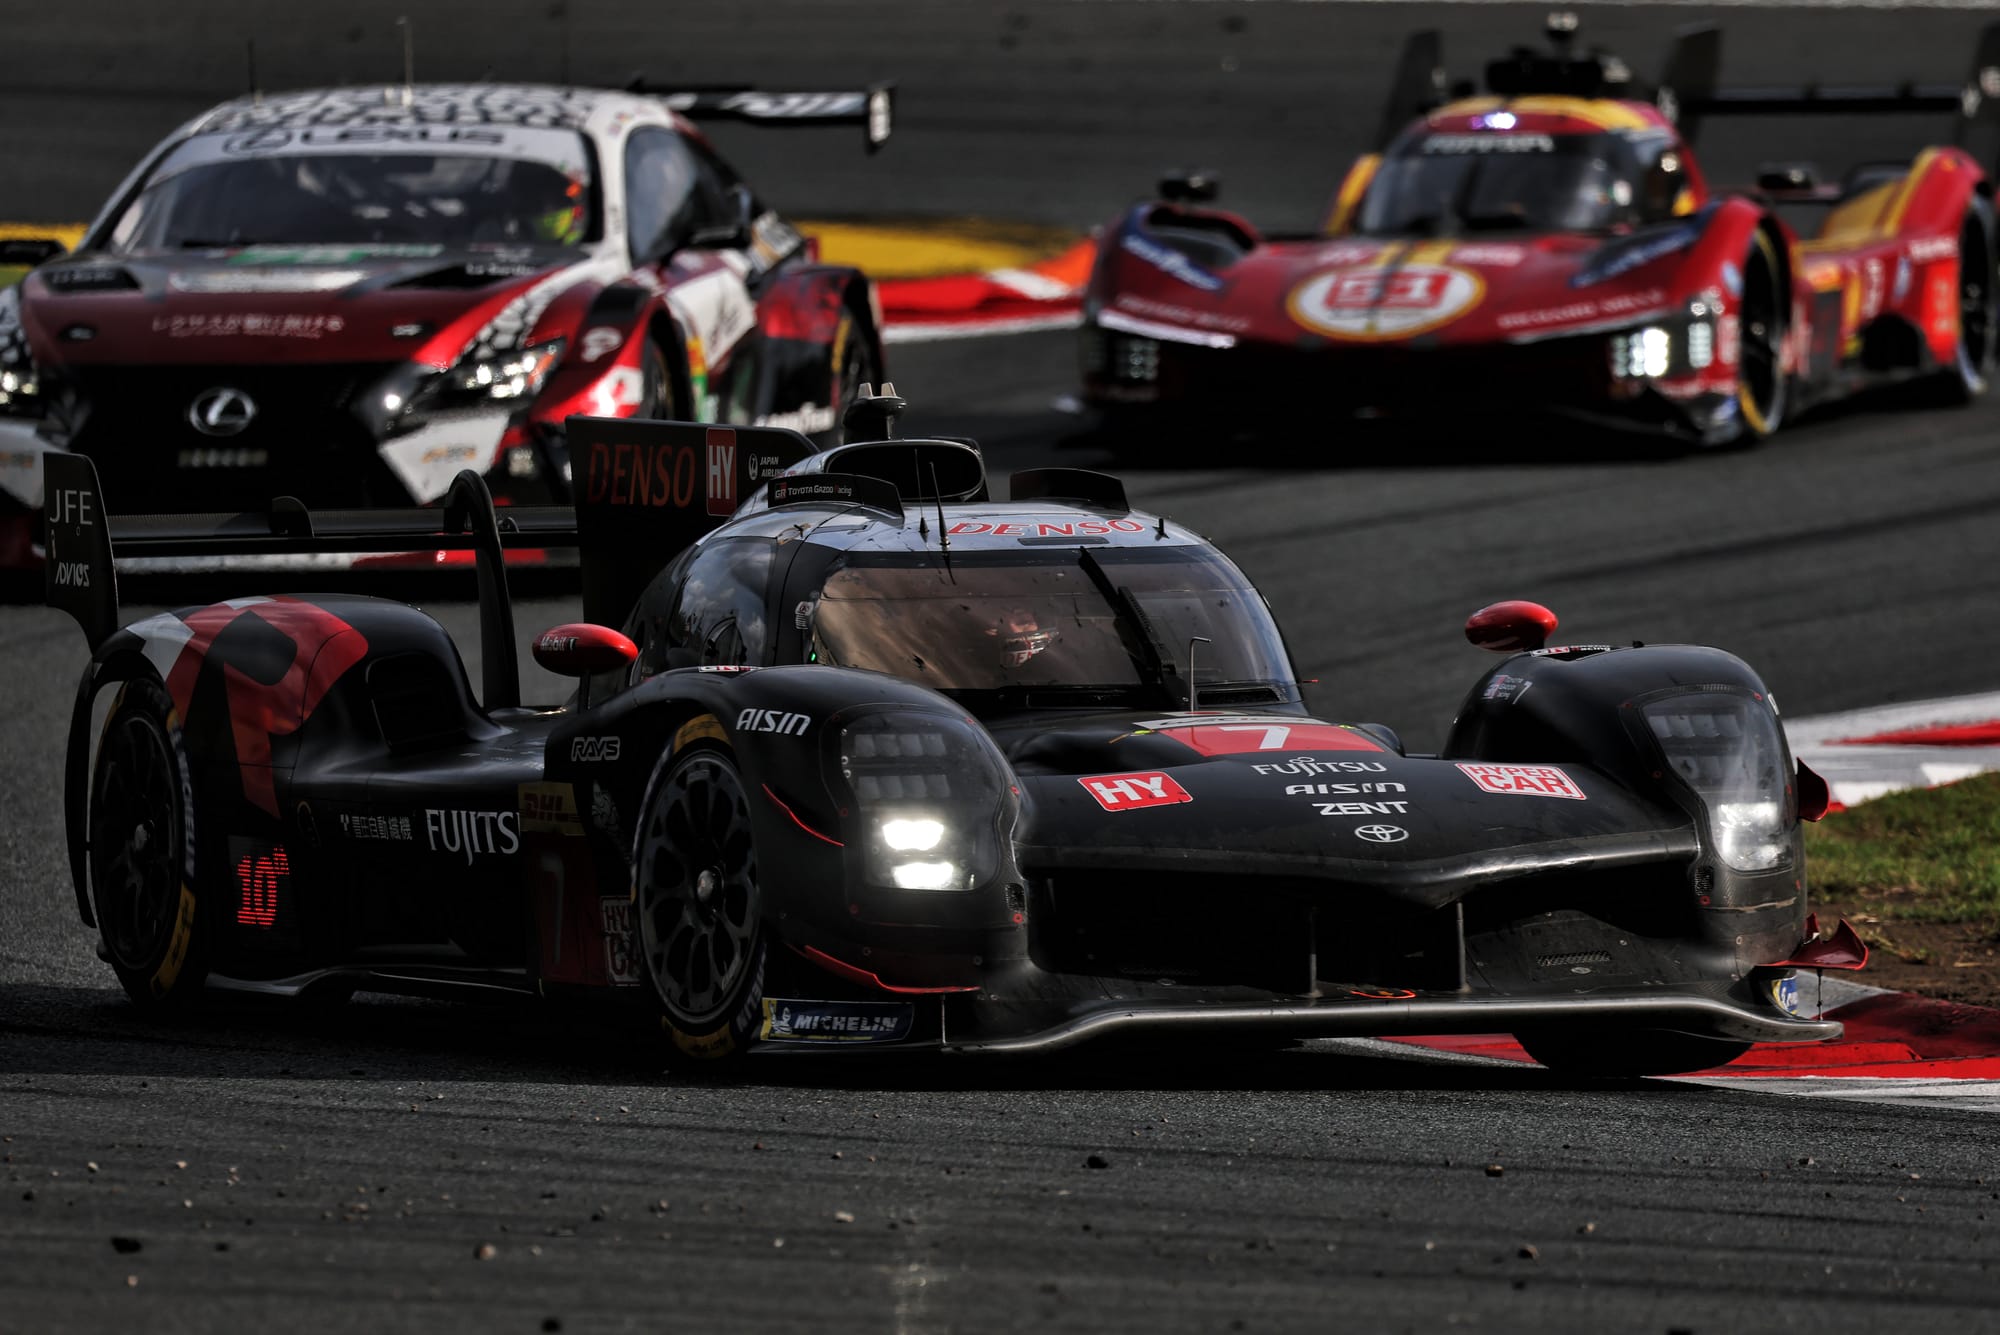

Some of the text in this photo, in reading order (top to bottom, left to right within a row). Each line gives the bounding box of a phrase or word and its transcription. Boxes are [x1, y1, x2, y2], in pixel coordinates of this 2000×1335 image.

[708, 446, 734, 499] HY
[760, 456, 779, 466] JAPAN
[588, 442, 697, 508] DENSO
[788, 486, 813, 496] TOYOTA
[49, 489, 93, 525] JFE
[947, 519, 1144, 536] DENSO
[736, 708, 811, 736] AISIN
[571, 736, 620, 762] RAYS
[1218, 725, 1290, 750] 7
[1250, 757, 1387, 777] FUJITSU
[1467, 766, 1559, 779] HYPER
[1090, 776, 1169, 805] HY
[1285, 782, 1407, 796] AISIN
[1480, 774, 1574, 795] CAR
[524, 793, 567, 820] DHL
[1312, 801, 1408, 816] ZENT
[425, 808, 520, 866] FUJITS
[793, 1014, 898, 1033] MICHELIN
